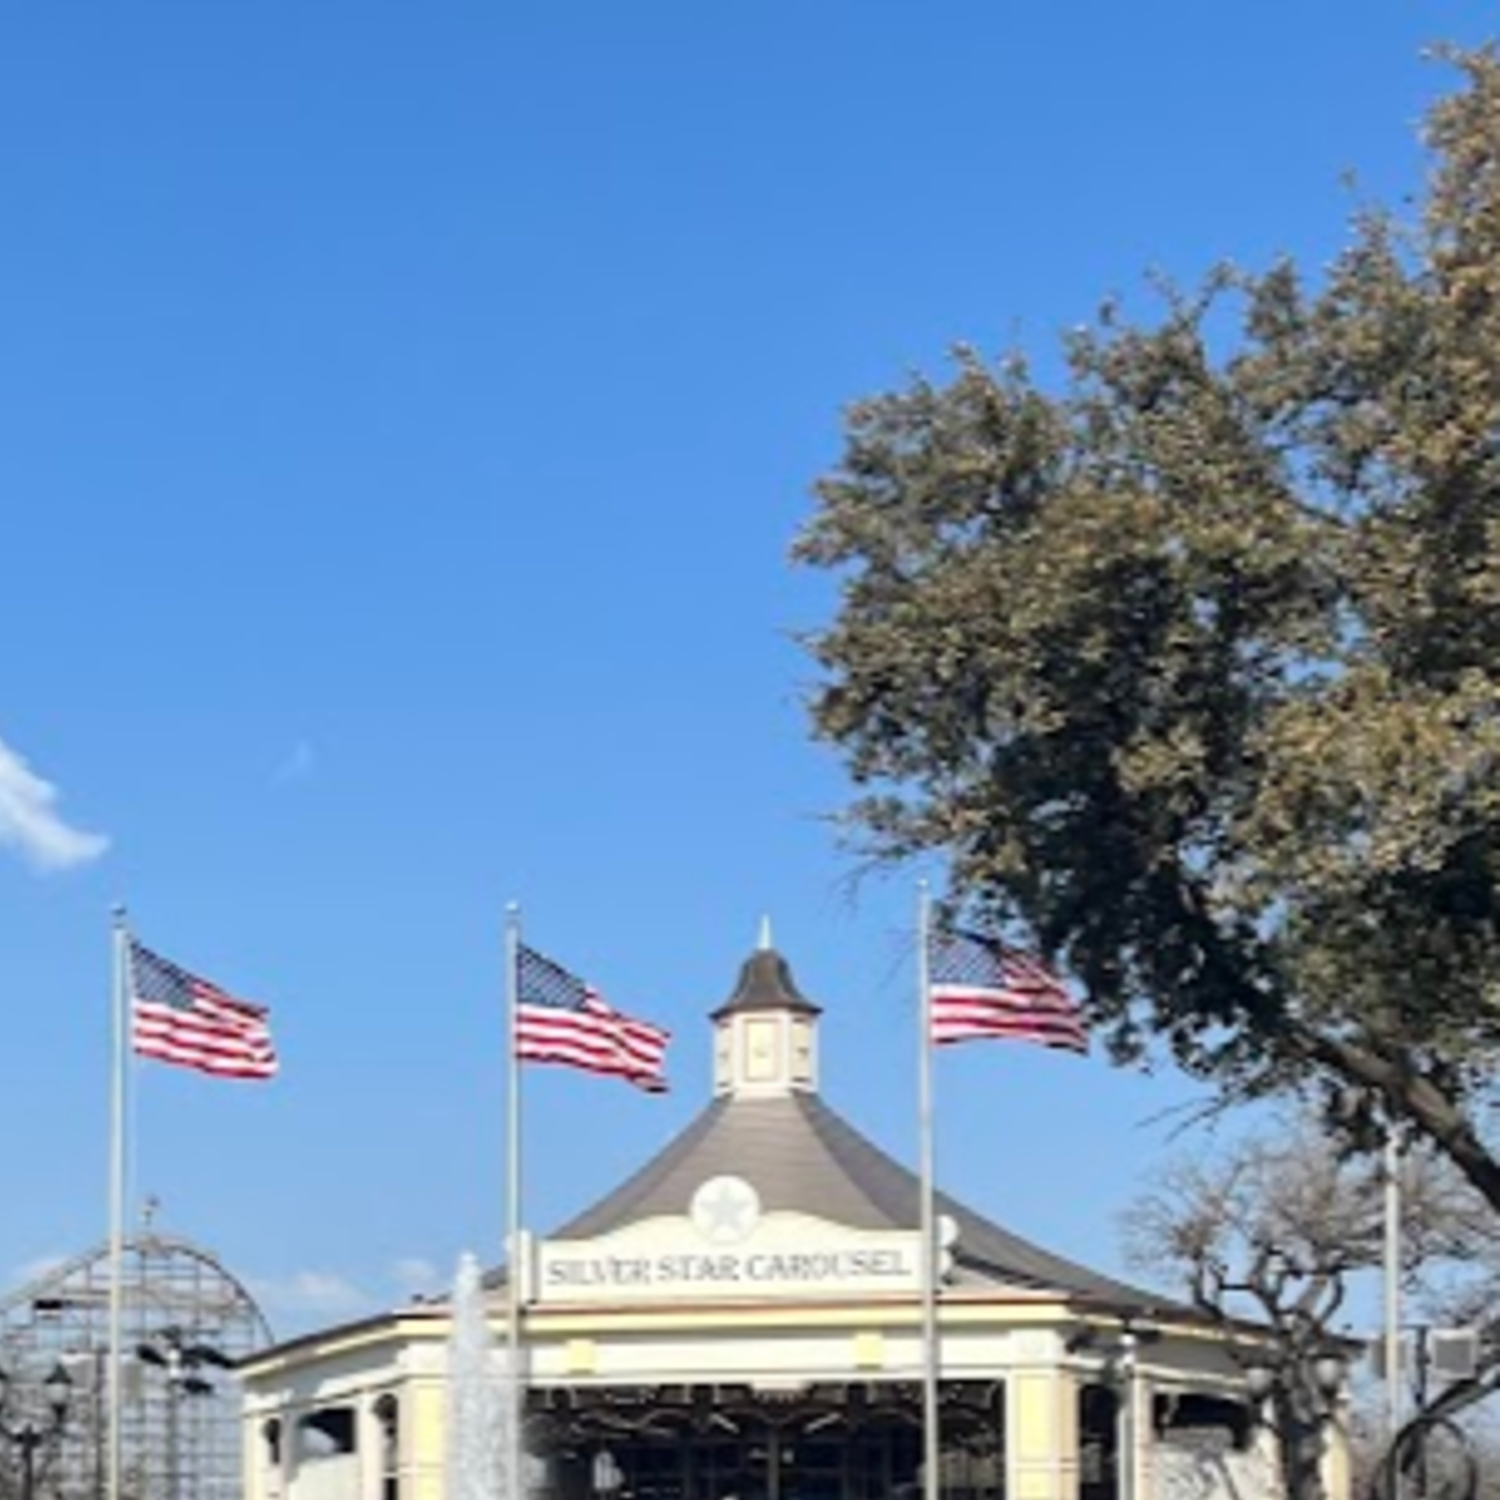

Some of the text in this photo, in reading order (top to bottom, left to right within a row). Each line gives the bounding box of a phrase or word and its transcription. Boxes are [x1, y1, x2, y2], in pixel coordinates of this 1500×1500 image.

[547, 1249, 912, 1286] SILVER STAR CAROUSEL
